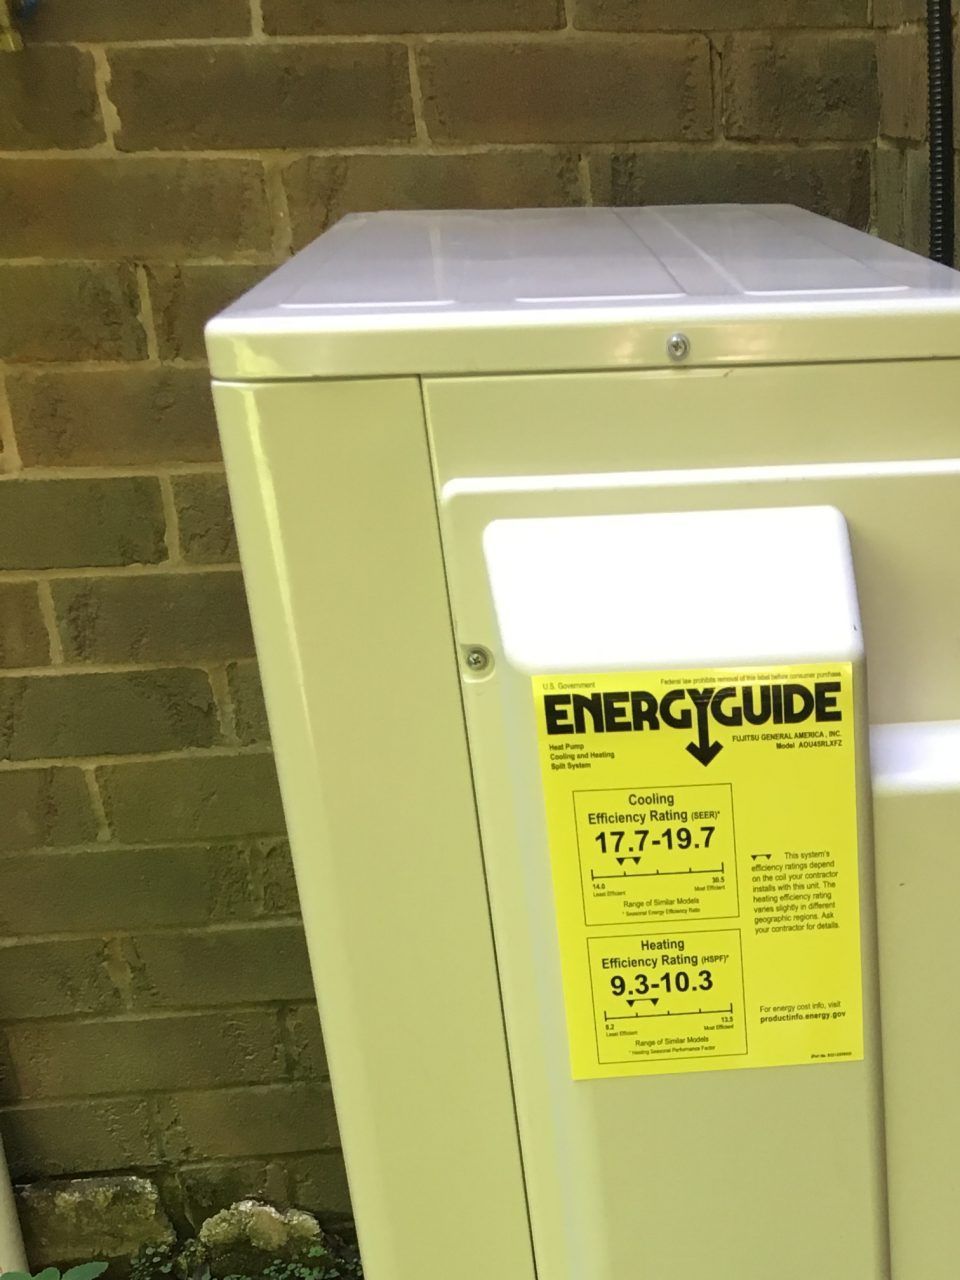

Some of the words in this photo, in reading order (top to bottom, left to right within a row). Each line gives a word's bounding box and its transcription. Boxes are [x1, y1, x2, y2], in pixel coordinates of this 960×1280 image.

[693, 677, 715, 685] prohibits
[544, 682, 842, 735] ENERGYGUIDE
[732, 734, 759, 742] FUJITSU
[761, 733, 793, 741] GENERAL
[776, 742, 795, 750] Model
[550, 753, 575, 761] Cooling
[568, 762, 591, 770] System
[628, 793, 674, 806] Cooling
[588, 812, 646, 825] Efficiency
[650, 810, 688, 823] Rating
[595, 826, 715, 853] 17.7-19.7
[784, 852, 799, 860] This
[801, 850, 830, 860] system's
[751, 864, 783, 872] efficiency
[785, 863, 807, 871] ratings
[809, 861, 834, 869] depend
[789, 873, 802, 881] your
[805, 871, 838, 879] contractor
[753, 885, 776, 893] installs
[753, 895, 778, 903] heating
[780, 894, 810, 902] efficiency
[813, 892, 831, 900] rating
[776, 904, 798, 913] slightly
[755, 915, 791, 925] geographic
[755, 926, 769, 935] your
[771, 924, 804, 933] contractor
[641, 939, 684, 951] Heating
[602, 957, 657, 969] Efficiency
[662, 954, 698, 966] Rating
[610, 970, 713, 996] 9.3-10.3
[773, 1005, 795, 1013] energy
